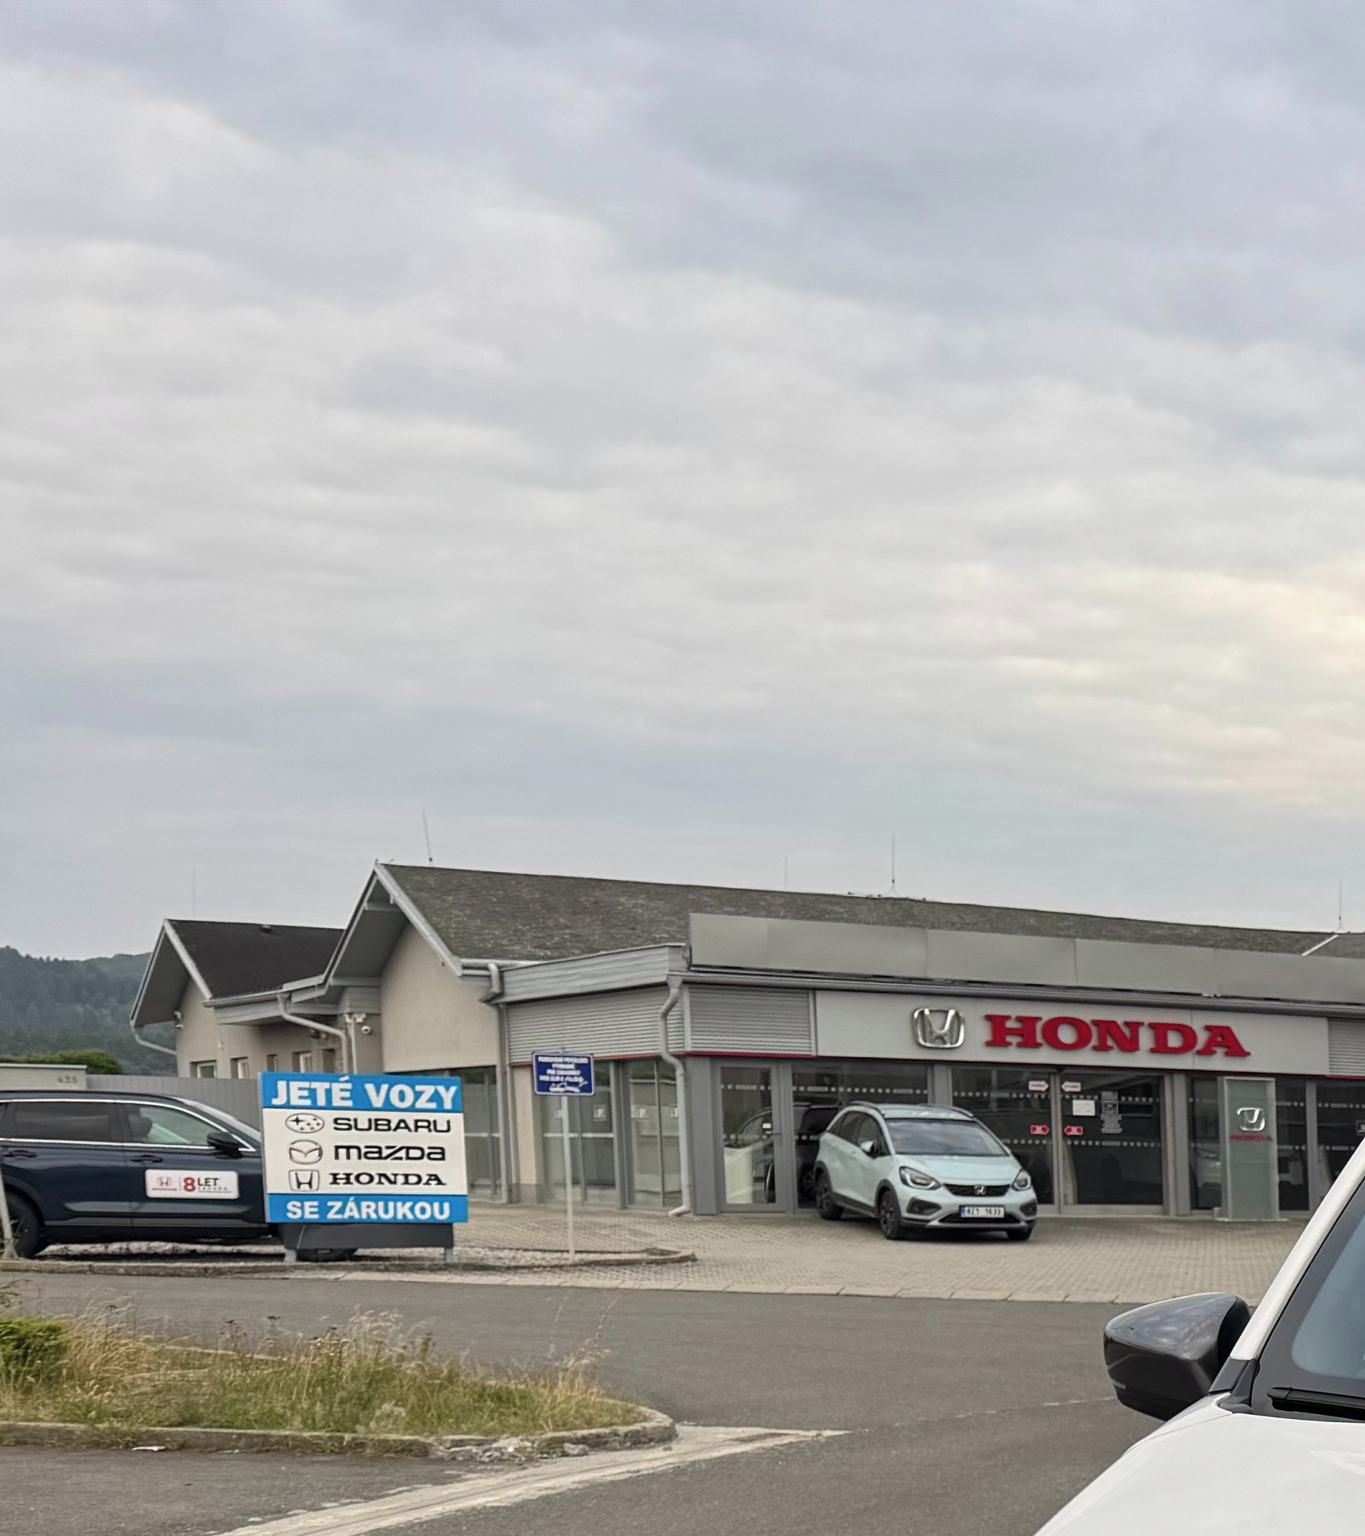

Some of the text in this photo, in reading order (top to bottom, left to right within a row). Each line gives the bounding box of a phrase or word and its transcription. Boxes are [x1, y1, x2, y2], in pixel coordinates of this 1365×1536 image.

[984, 1014, 1251, 1057] HONDA
[271, 1076, 457, 1110] JETÉ VOZY
[333, 1117, 451, 1133] SUBARU
[183, 1176, 220, 1192] 8 LET
[329, 1172, 447, 1186] HONDA
[286, 1196, 450, 1220] SE ZÁRUKOU
